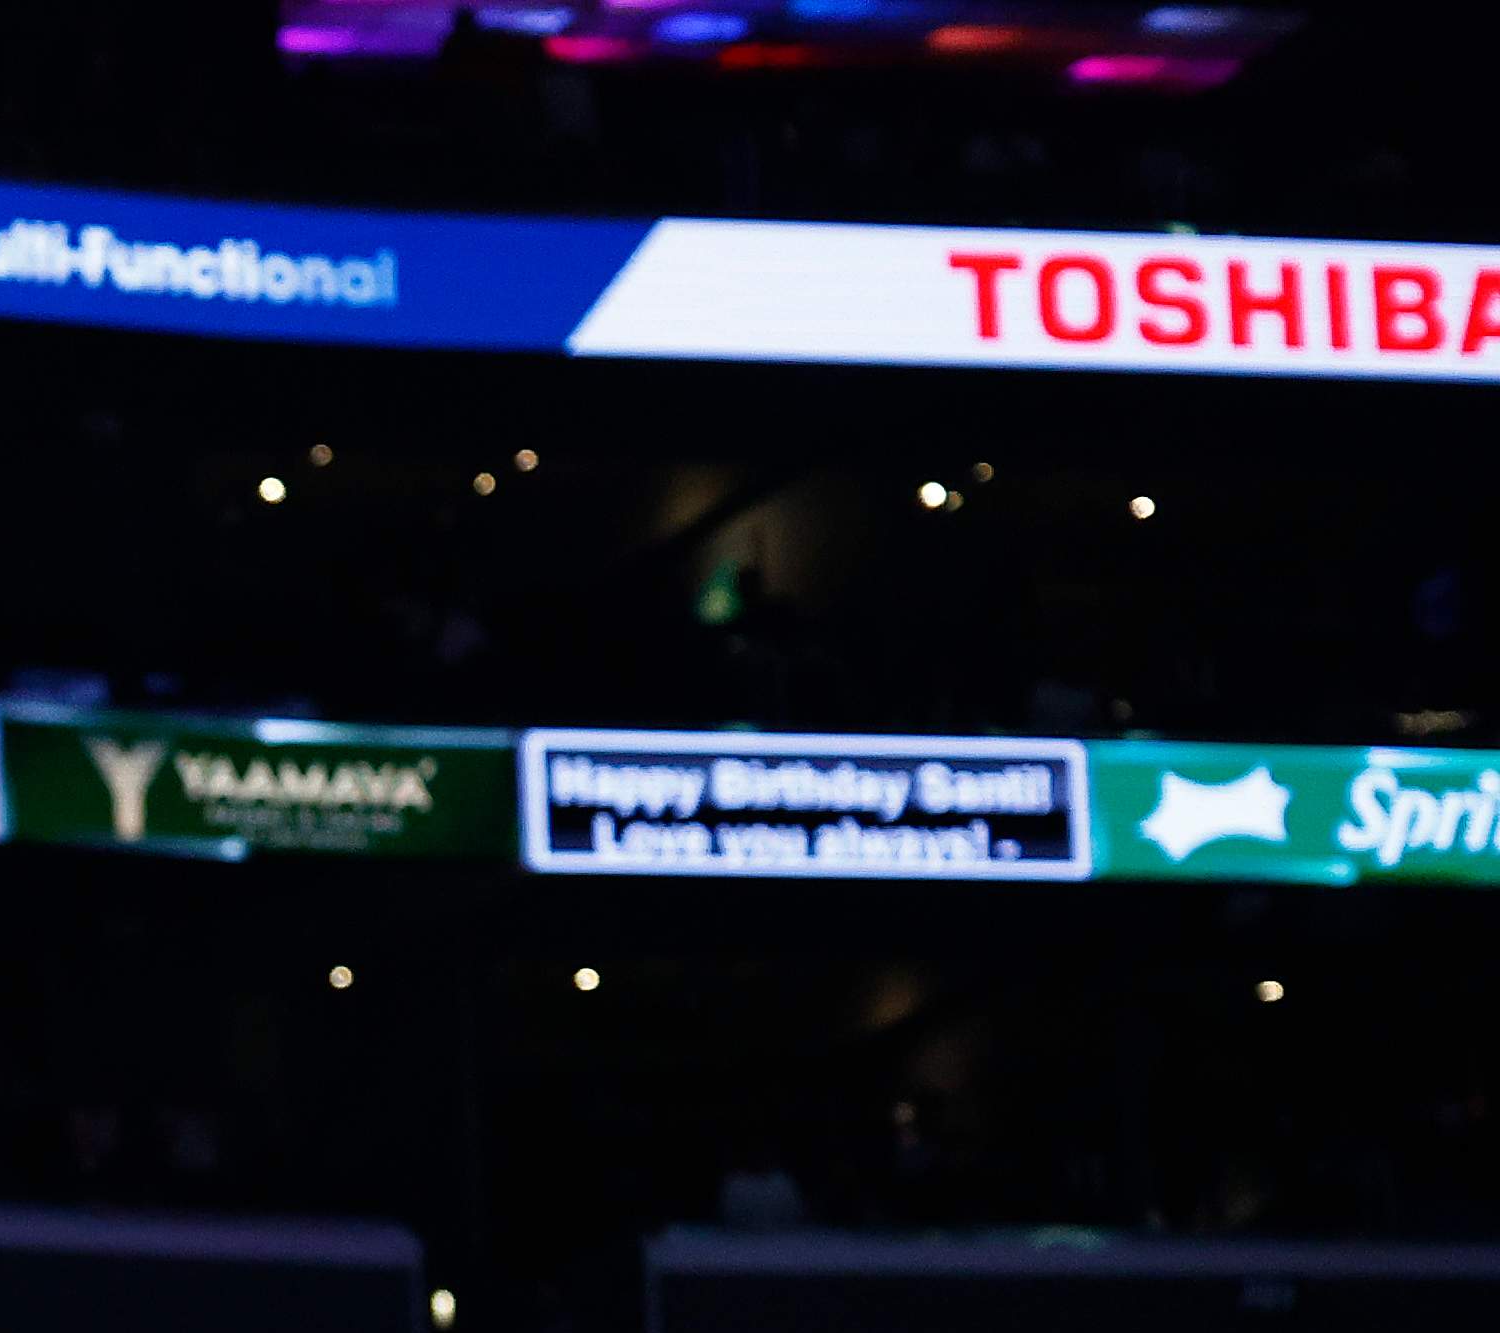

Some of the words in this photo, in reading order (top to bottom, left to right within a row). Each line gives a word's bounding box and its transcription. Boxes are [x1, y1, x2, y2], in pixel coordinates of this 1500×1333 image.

[552, 759, 704, 815] Happy
[712, 760, 909, 819] Birthday
[1338, 765, 1500, 867] Spri
